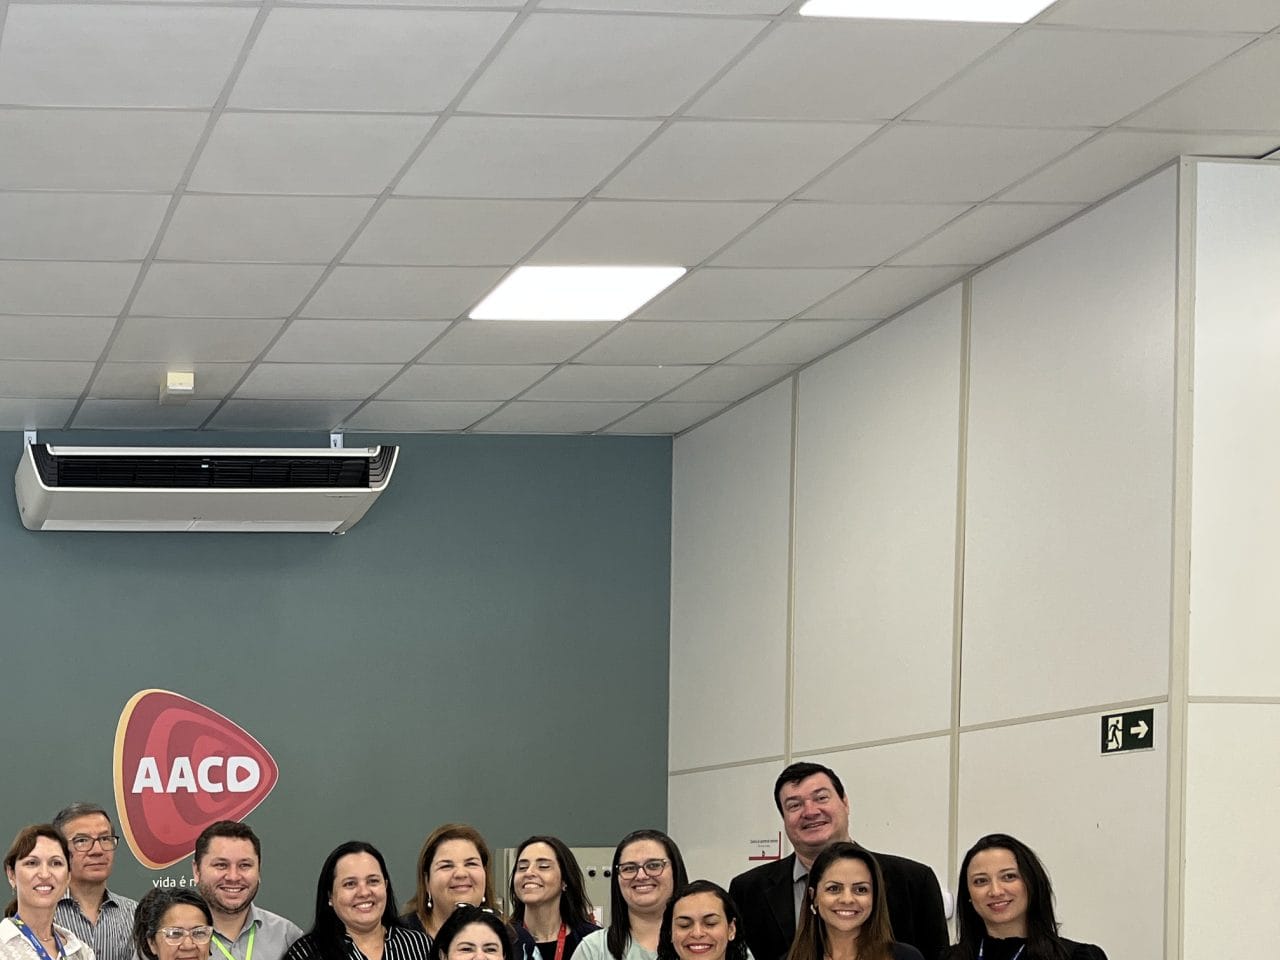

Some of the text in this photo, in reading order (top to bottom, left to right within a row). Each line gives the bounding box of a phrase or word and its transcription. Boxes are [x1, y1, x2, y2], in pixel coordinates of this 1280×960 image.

[131, 756, 261, 794] AACD
[152, 876, 177, 888] vida
[179, 875, 187, 888] é
